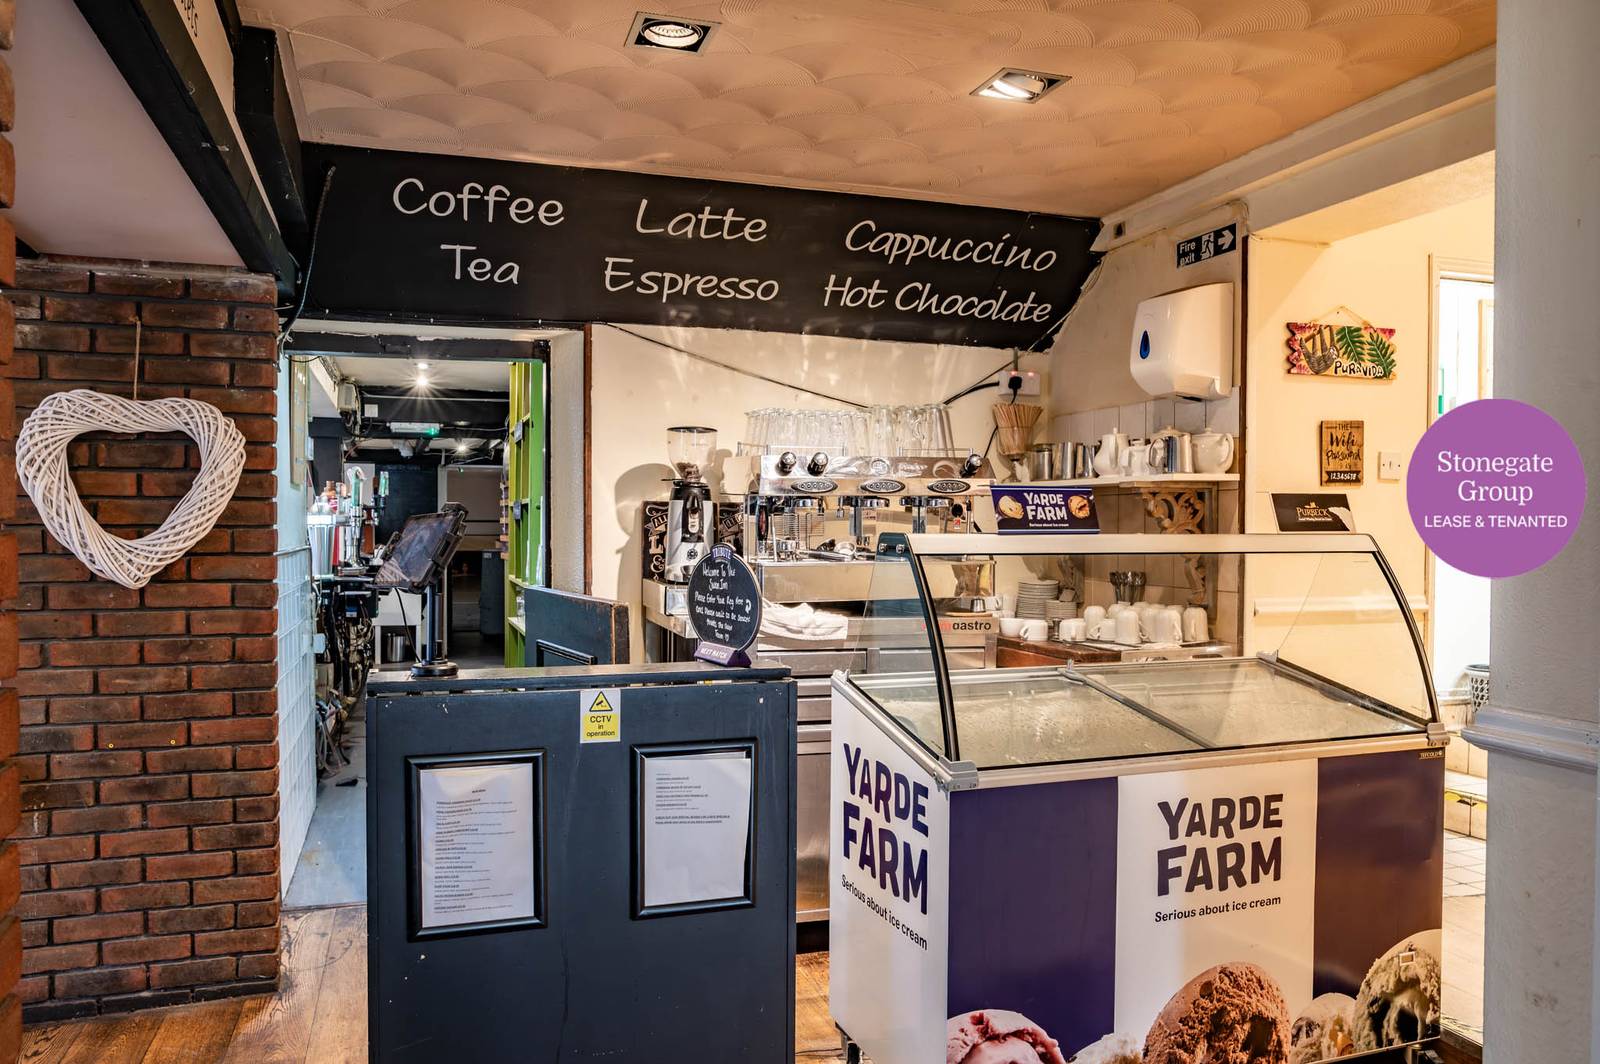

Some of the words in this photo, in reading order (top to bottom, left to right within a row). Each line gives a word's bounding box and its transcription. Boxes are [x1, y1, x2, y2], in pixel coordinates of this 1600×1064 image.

[392, 177, 565, 226] Coffee
[635, 198, 768, 242] Latte
[845, 219, 1057, 272] Cappuccino
[1180, 242, 1195, 254] Fire
[1180, 253, 1195, 266] exit
[440, 244, 520, 285] Tea
[604, 256, 780, 303] Espresso
[823, 274, 888, 308] Hot
[894, 281, 1053, 323] Chocolate
[1329, 431, 1355, 452] Wifi
[1023, 492, 1065, 506] YARDE
[1026, 506, 1068, 521] FARM
[1295, 507, 1331, 518] PURBECK
[703, 561, 719, 577] Welcome
[711, 547, 731, 560] TRIBUTE
[586, 730, 616, 738] operation
[589, 715, 612, 723] CCTV
[843, 742, 929, 838] YARDE
[1157, 793, 1284, 841] YARDE
[843, 800, 928, 915] FARM
[1157, 836, 1282, 897] FARM
[841, 874, 866, 904] Serious
[866, 896, 888, 921] about
[888, 911, 901, 930] ice
[901, 921, 928, 951] cream
[1154, 909, 1197, 923] Serious
[1198, 902, 1230, 917] about
[1231, 900, 1248, 911] ice
[1249, 896, 1282, 909] cream
